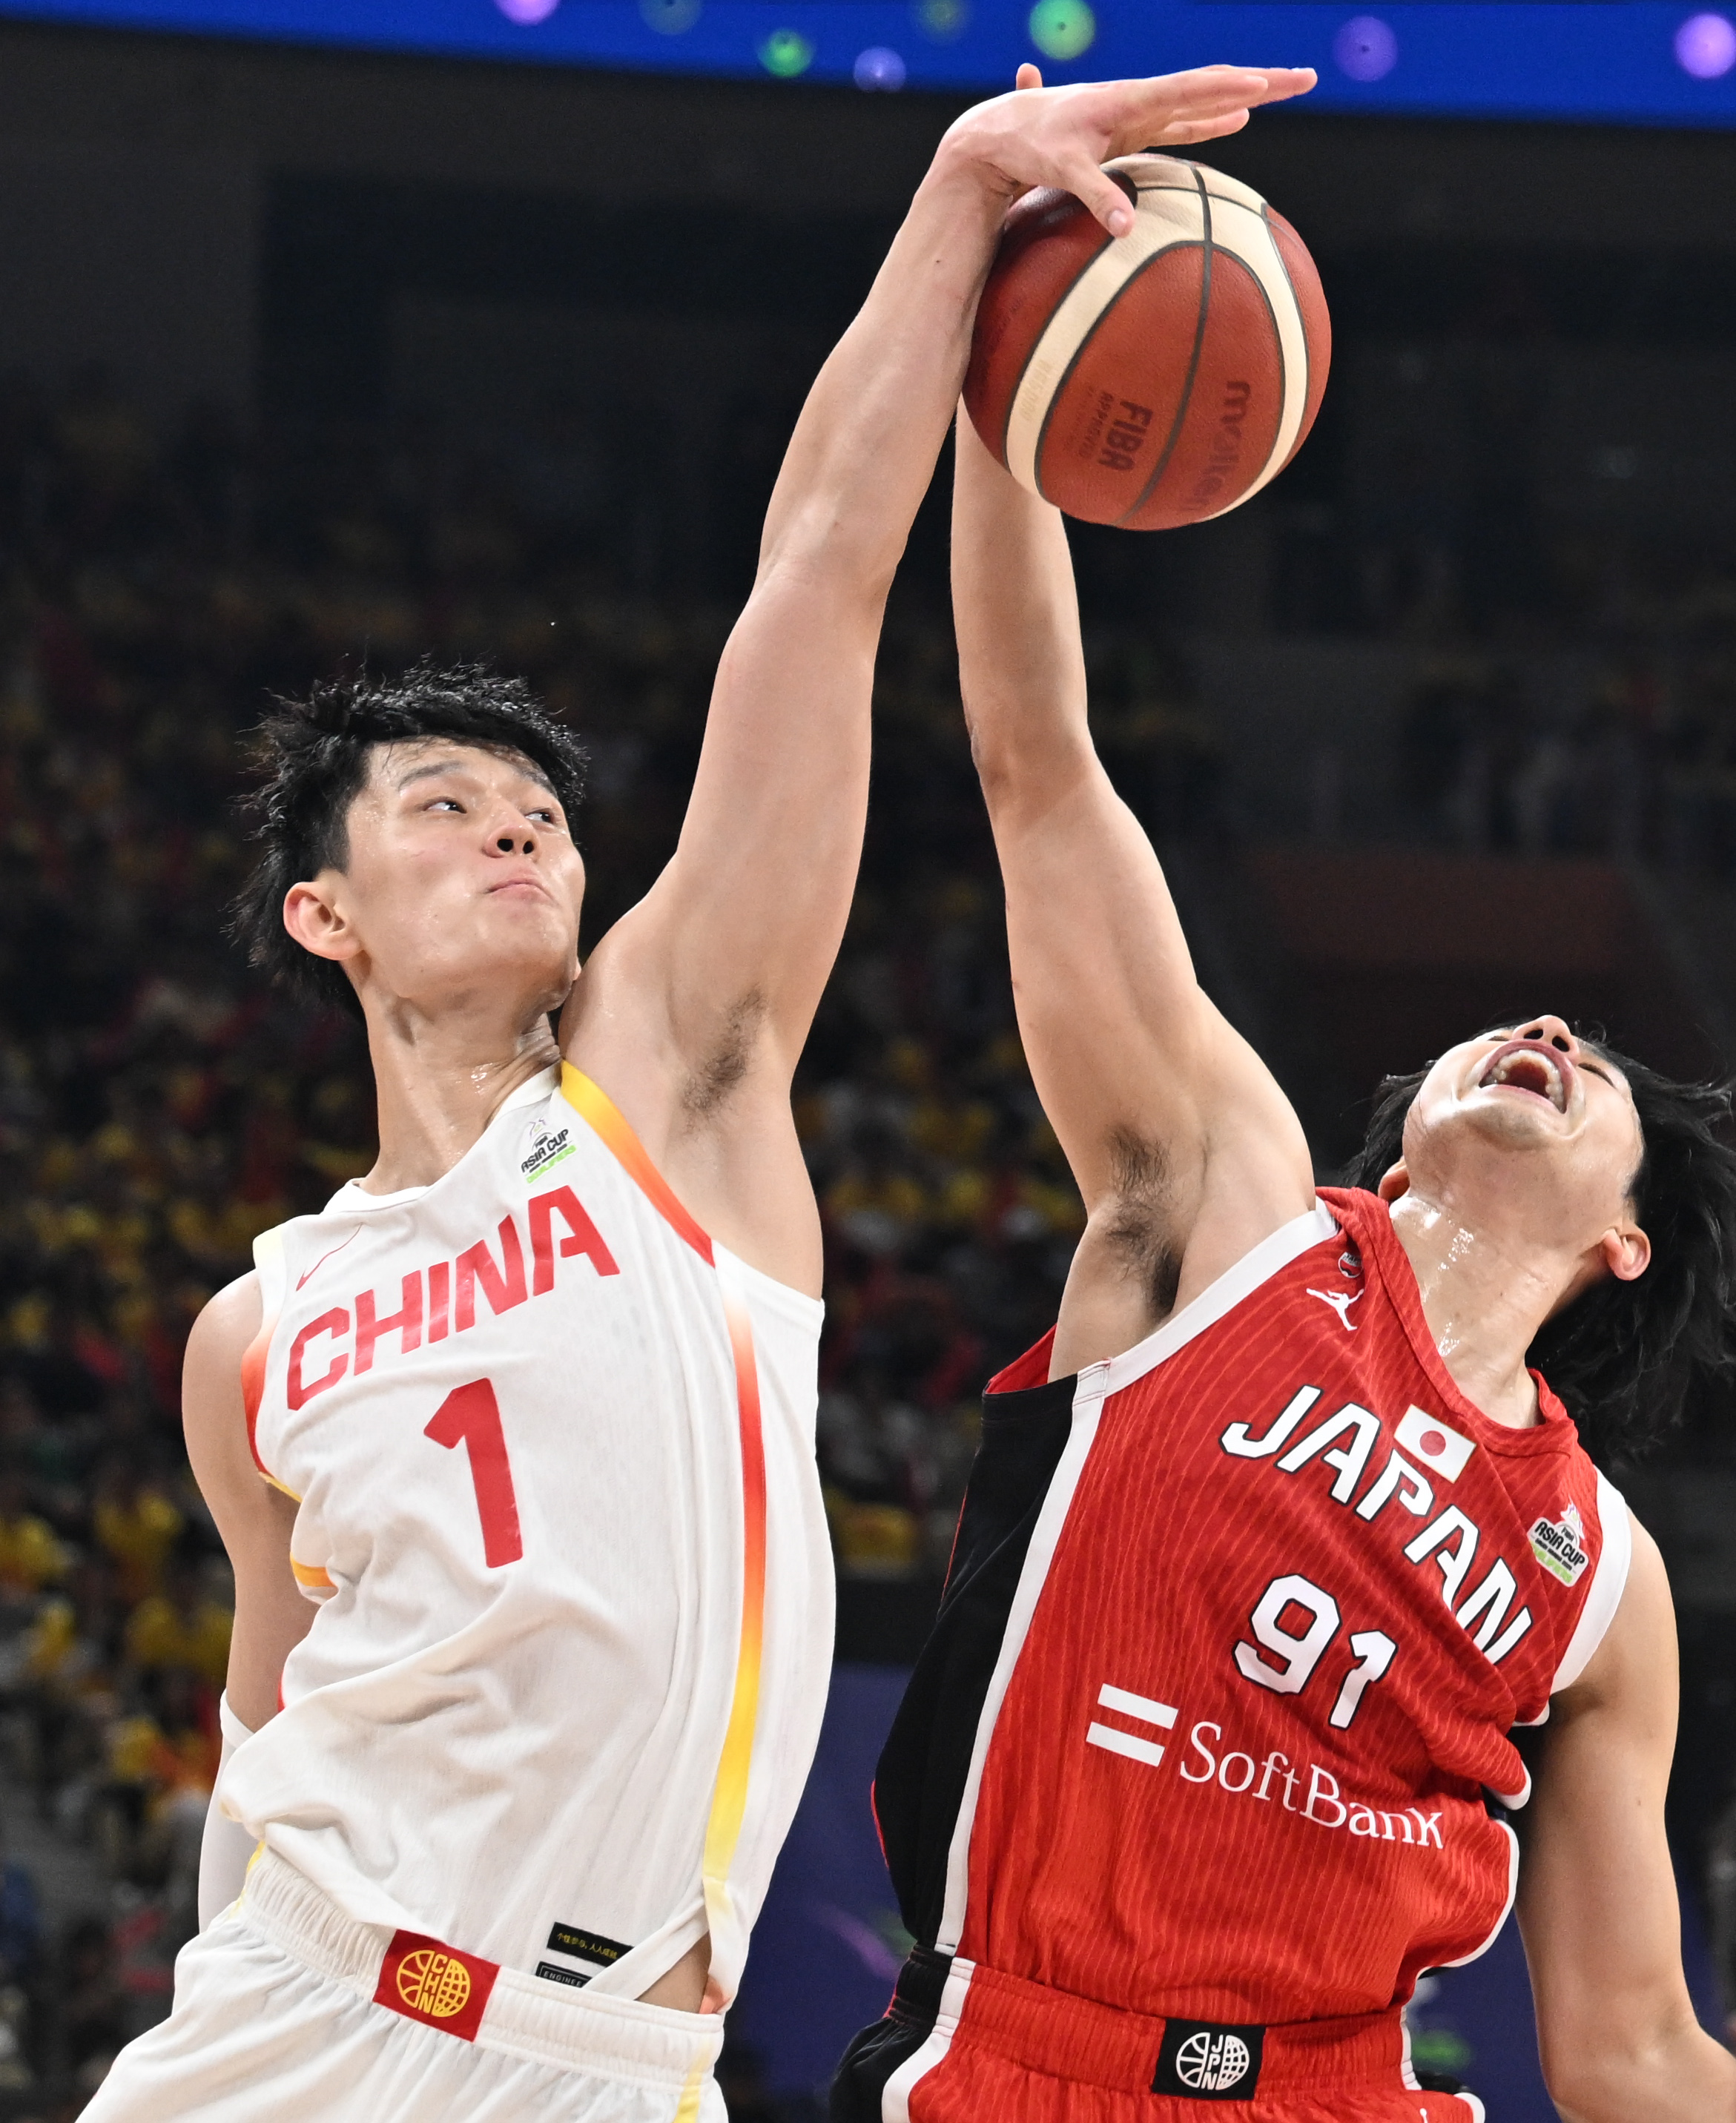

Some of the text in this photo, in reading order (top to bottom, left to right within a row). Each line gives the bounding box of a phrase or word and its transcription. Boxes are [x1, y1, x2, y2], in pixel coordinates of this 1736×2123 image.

[1098, 400, 1153, 471] FIBA
[521, 1146, 547, 1173] ASIA
[547, 1129, 569, 1152] CUP
[287, 1185, 621, 1411] CHINA
[423, 1377, 523, 1568] 1
[1218, 1384, 1533, 1668] JAPAN
[1534, 1521, 1564, 1550] ASIA
[1561, 1543, 1585, 1566] CUP
[1232, 1574, 1399, 1729] 91
[1180, 1721, 1444, 1849] SoftBank
[418, 1953, 448, 2015] CHN
[1201, 2034, 1224, 2090] JPN
